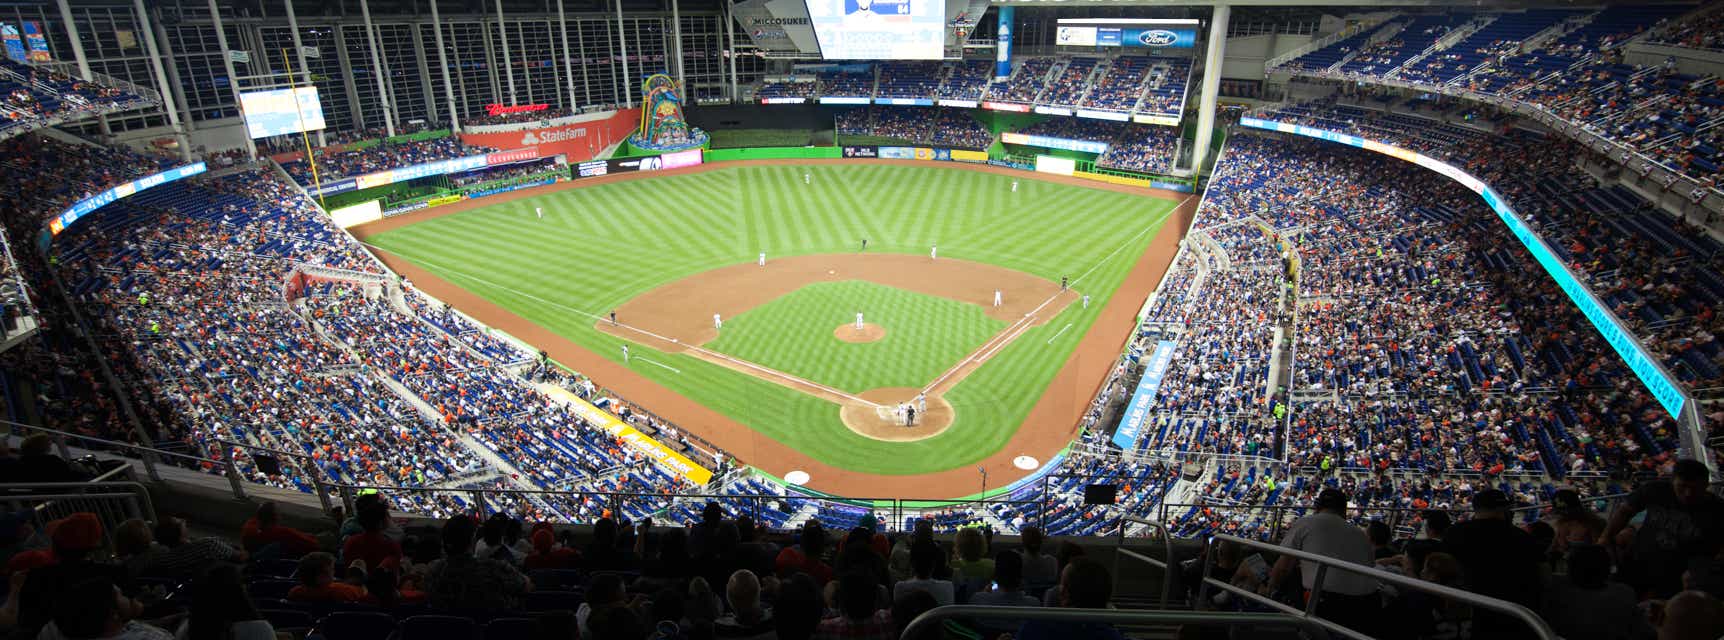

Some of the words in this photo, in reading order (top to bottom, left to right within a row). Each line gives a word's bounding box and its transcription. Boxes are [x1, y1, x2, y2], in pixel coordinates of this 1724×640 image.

[752, 17, 808, 25] MICCOSUKEE
[1145, 32, 1169, 44] Ford
[664, 457, 693, 474] PARK
